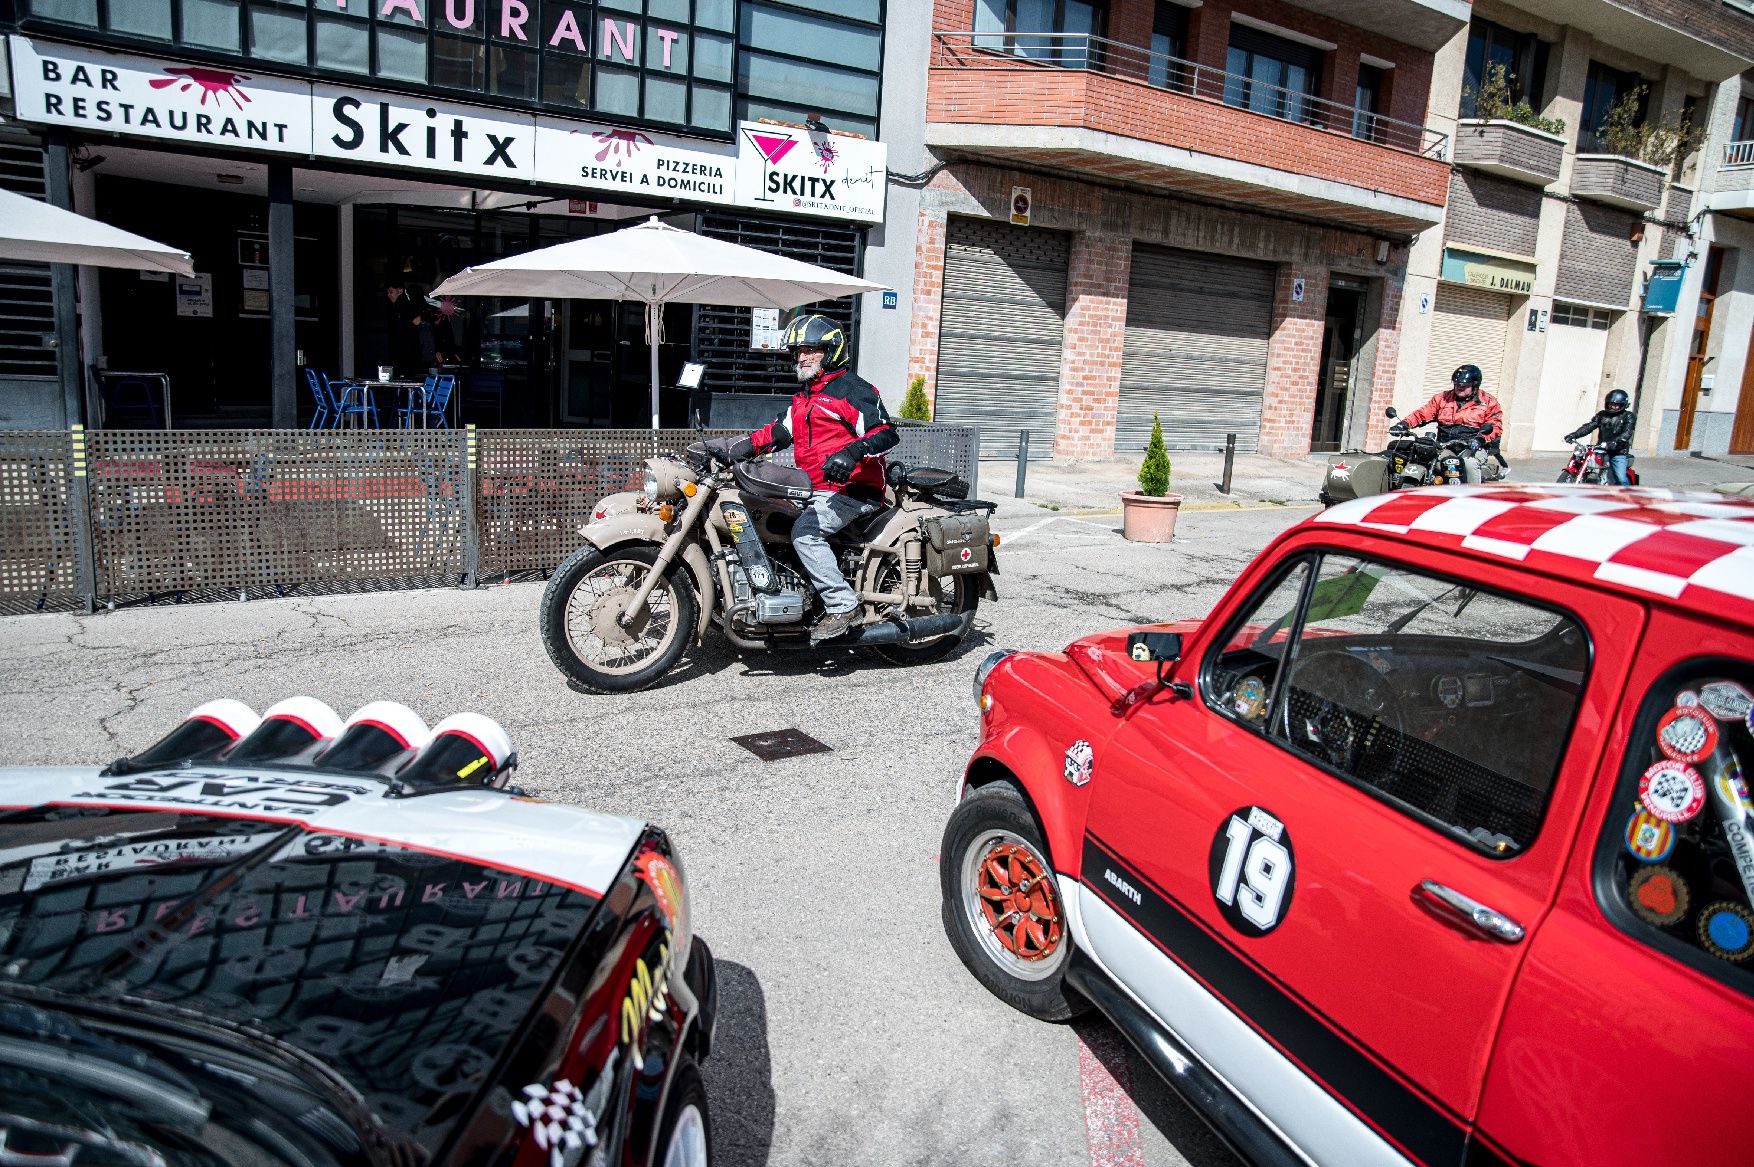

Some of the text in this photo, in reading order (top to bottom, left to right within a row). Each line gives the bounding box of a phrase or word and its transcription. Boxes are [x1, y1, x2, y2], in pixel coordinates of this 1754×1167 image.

[42, 59, 121, 92] BAR
[44, 92, 288, 143] RESTAURANT
[331, 96, 518, 169] Skitx
[581, 166, 723, 195] SERVEI A DOMICILI
[657, 158, 723, 178] PIZZERIA
[768, 171, 837, 200] SKITX
[1490, 275, 1496, 287] J.
[1500, 277, 1532, 293] DALMAU
[1104, 868, 1142, 906] ABARTH
[1216, 814, 1292, 931] 19
